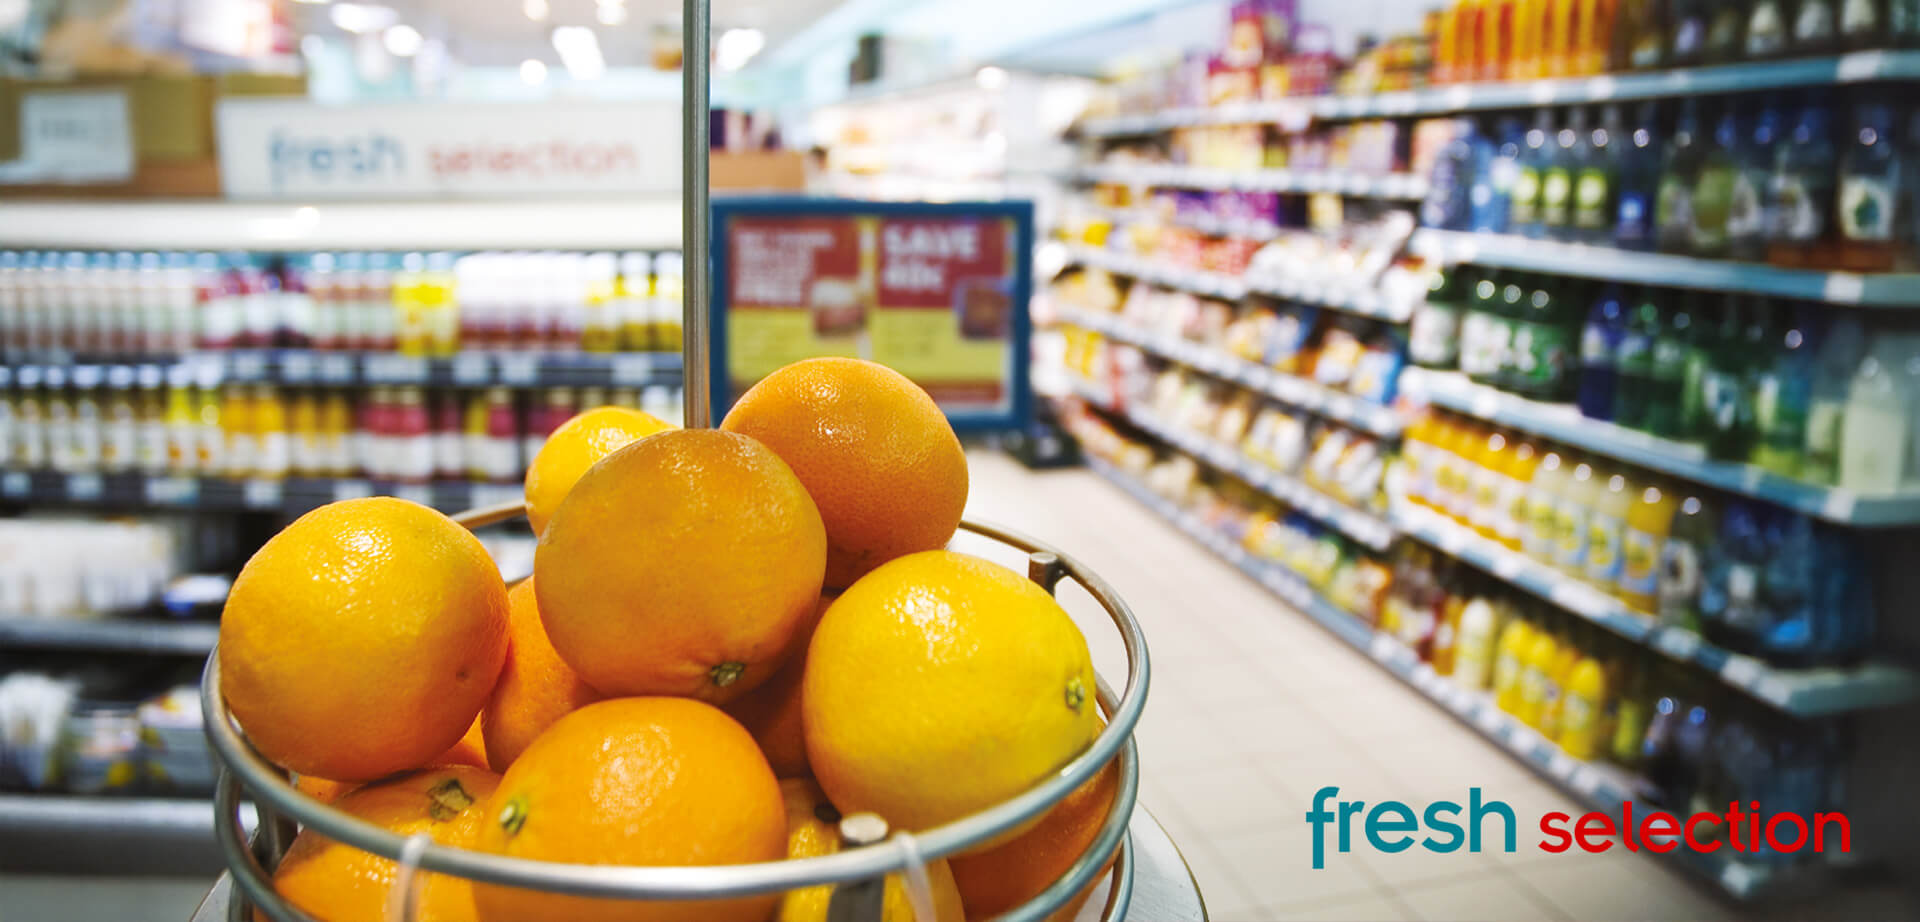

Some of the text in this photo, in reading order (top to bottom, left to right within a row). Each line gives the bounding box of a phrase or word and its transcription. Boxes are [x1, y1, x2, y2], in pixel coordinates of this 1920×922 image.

[269, 130, 640, 192] fresh selection
[884, 223, 981, 262] SAVE
